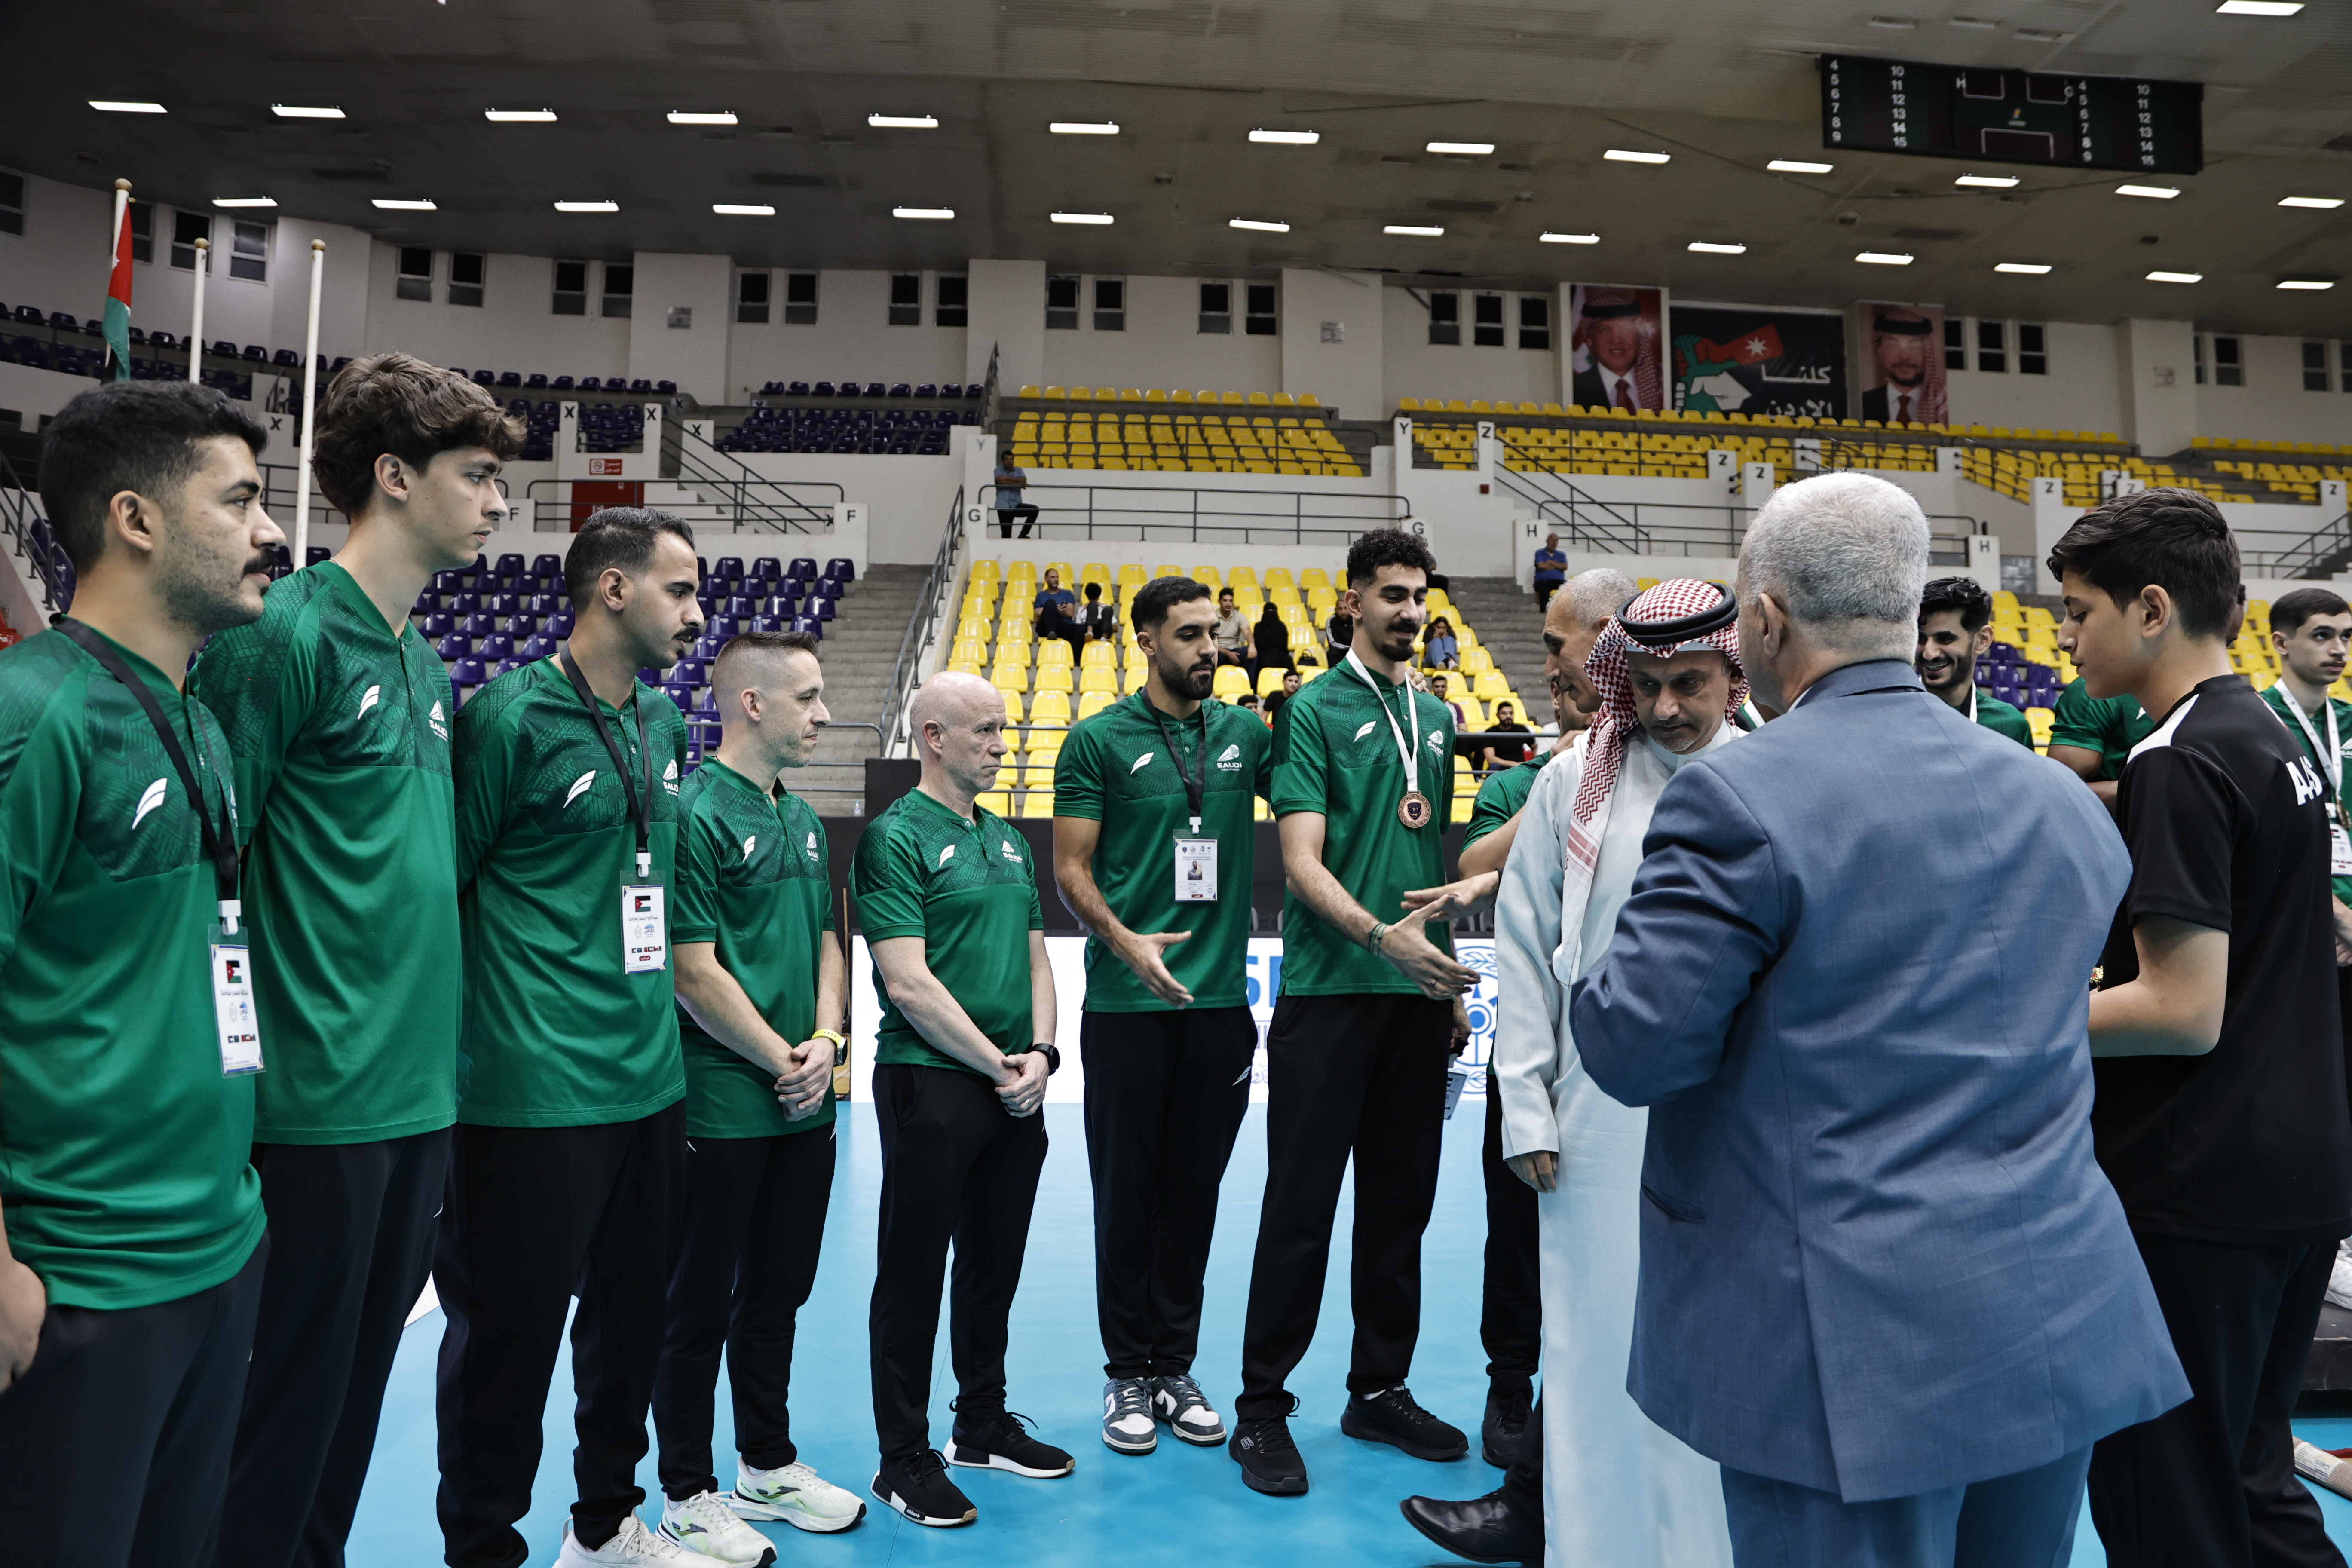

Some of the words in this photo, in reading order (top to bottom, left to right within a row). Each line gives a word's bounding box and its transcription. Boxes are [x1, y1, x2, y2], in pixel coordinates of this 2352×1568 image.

[1830, 59, 1839, 70] 4
[1890, 65, 1905, 77] 10
[1831, 74, 1839, 86] 5
[1891, 79, 1903, 91] 11
[1957, 78, 1966, 88] H
[2078, 80, 2086, 91] 4
[1831, 88, 1840, 100] 6
[2136, 84, 2150, 95] 10
[1891, 93, 1905, 105] 12
[2079, 94, 2088, 106] 5
[2137, 98, 2148, 109] 11
[1831, 102, 1840, 114] 7
[1892, 107, 1906, 120] 13
[2079, 108, 2089, 120] 6
[1832, 116, 1841, 129] 8
[2138, 112, 2151, 123] 12
[1892, 122, 1907, 134] 14
[2081, 122, 2089, 134] 7
[2139, 126, 2153, 138] 13
[1832, 131, 1841, 142] 9
[1893, 136, 1907, 147] 15
[2082, 136, 2091, 148] 8
[2140, 141, 2153, 152] 14
[2082, 151, 2092, 162] 9
[2141, 155, 2155, 165] 15
[1761, 364, 1832, 384] كلنا
[674, 398, 683, 409] X
[564, 405, 575, 418] X
[646, 407, 657, 420] X
[1327, 409, 1333, 420] Y
[270, 416, 283, 431] X
[692, 423, 702, 435] X
[1400, 422, 1409, 434] Y
[1482, 426, 1492, 438] Z
[975, 438, 986, 451] Y
[1719, 453, 1728, 466] Z
[1756, 466, 1765, 478] Z
[2045, 481, 2054, 493] Z
[2127, 483, 2136, 494] Z
[2329, 484, 2337, 495] Z
[510, 507, 519, 520] F
[847, 509, 856, 522] F
[968, 508, 981, 522] G
[1412, 521, 1424, 536] G
[1527, 524, 1538, 537] H
[1979, 539, 1990, 552] H
[1427, 740, 1443, 755] SAUDI
[663, 781, 679, 792] SAUD
